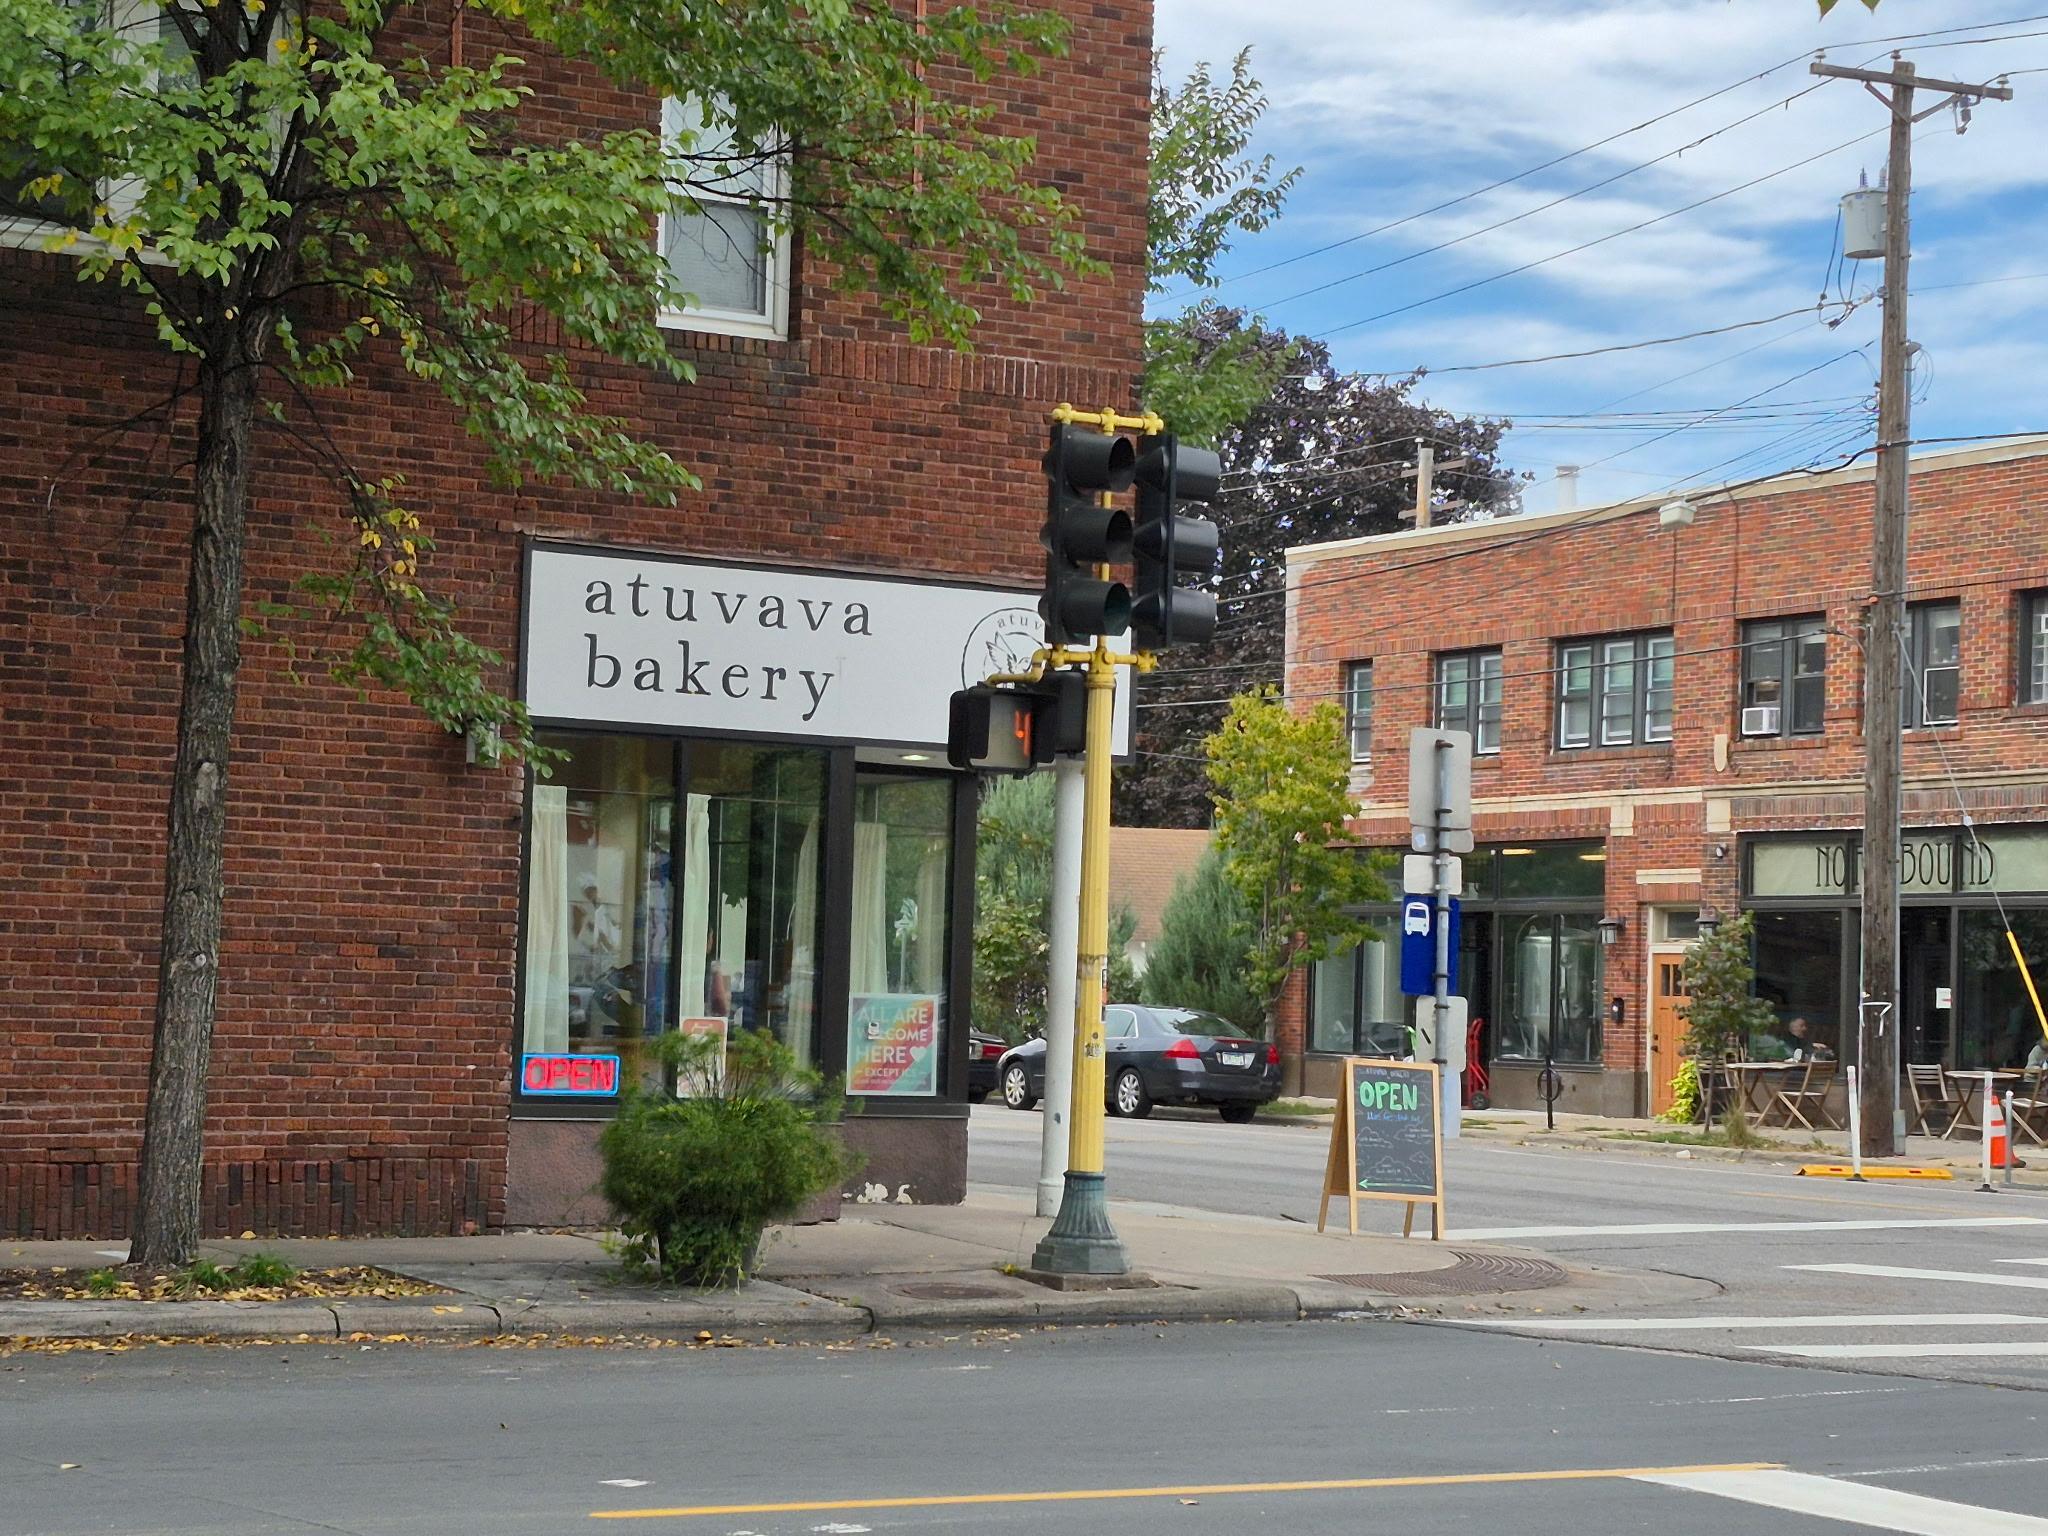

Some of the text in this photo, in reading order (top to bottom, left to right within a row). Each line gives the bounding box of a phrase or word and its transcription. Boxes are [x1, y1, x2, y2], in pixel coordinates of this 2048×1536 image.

[585, 573, 872, 636] atuvava
[997, 614, 1043, 630] atuv
[584, 633, 835, 721] bakery
[1816, 841, 1994, 888] NOBOUND
[857, 1007, 928, 1024] ALL ARE
[856, 1045, 907, 1063] HERE
[525, 1057, 615, 1090] OPEN
[864, 1067, 899, 1077] EXCEPT
[1359, 1081, 1418, 1111] OPEN
